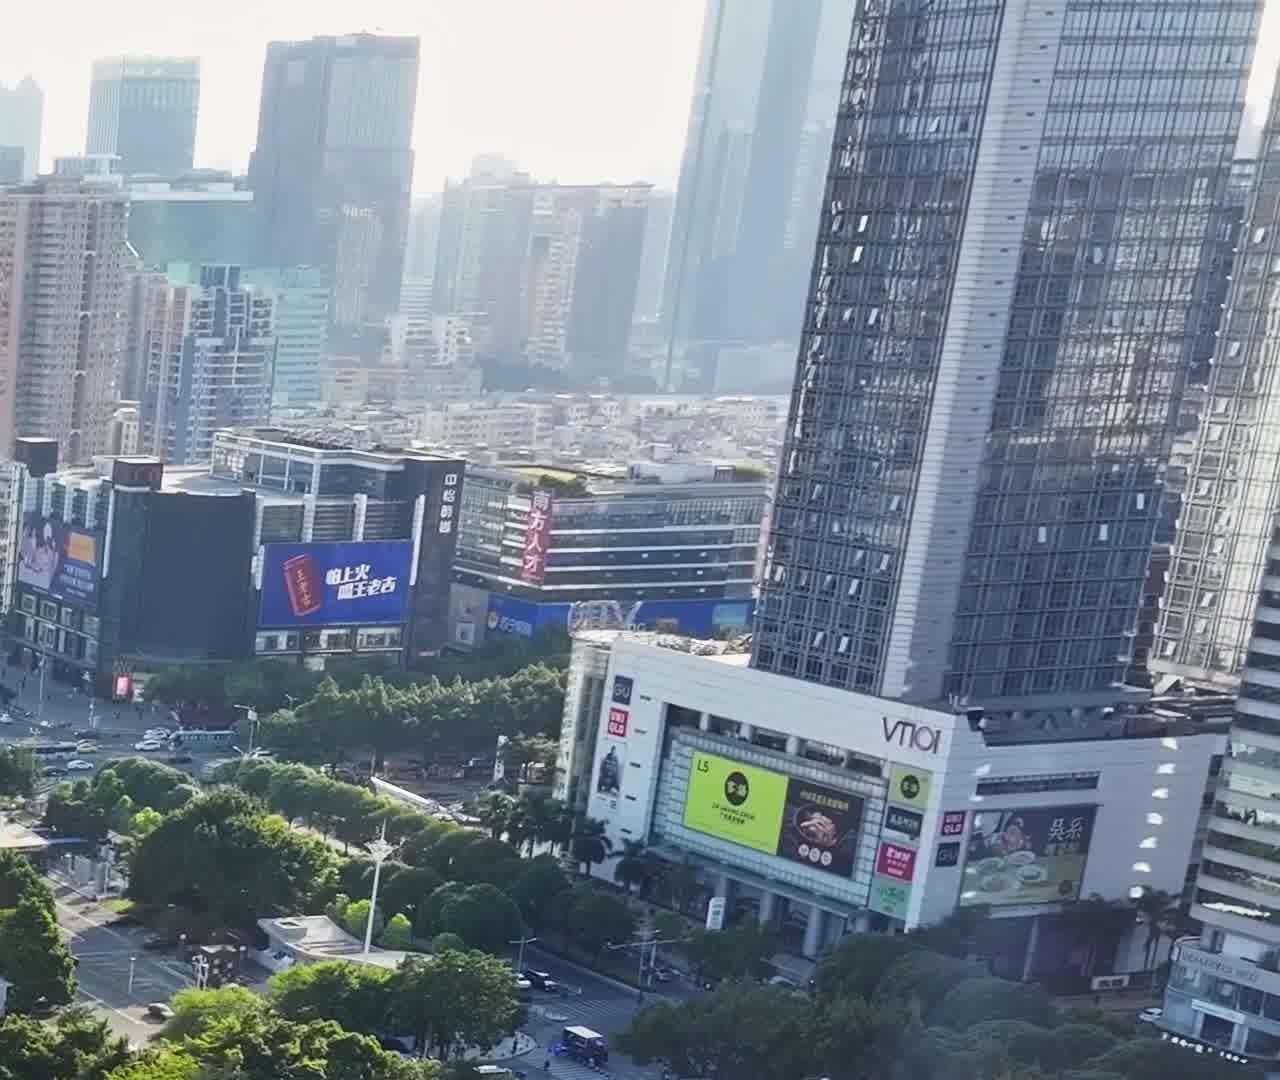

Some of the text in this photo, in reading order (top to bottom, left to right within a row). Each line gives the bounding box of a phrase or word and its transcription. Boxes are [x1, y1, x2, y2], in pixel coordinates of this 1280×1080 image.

[524, 490, 550, 570] 南方人才
[614, 685, 630, 698] GU
